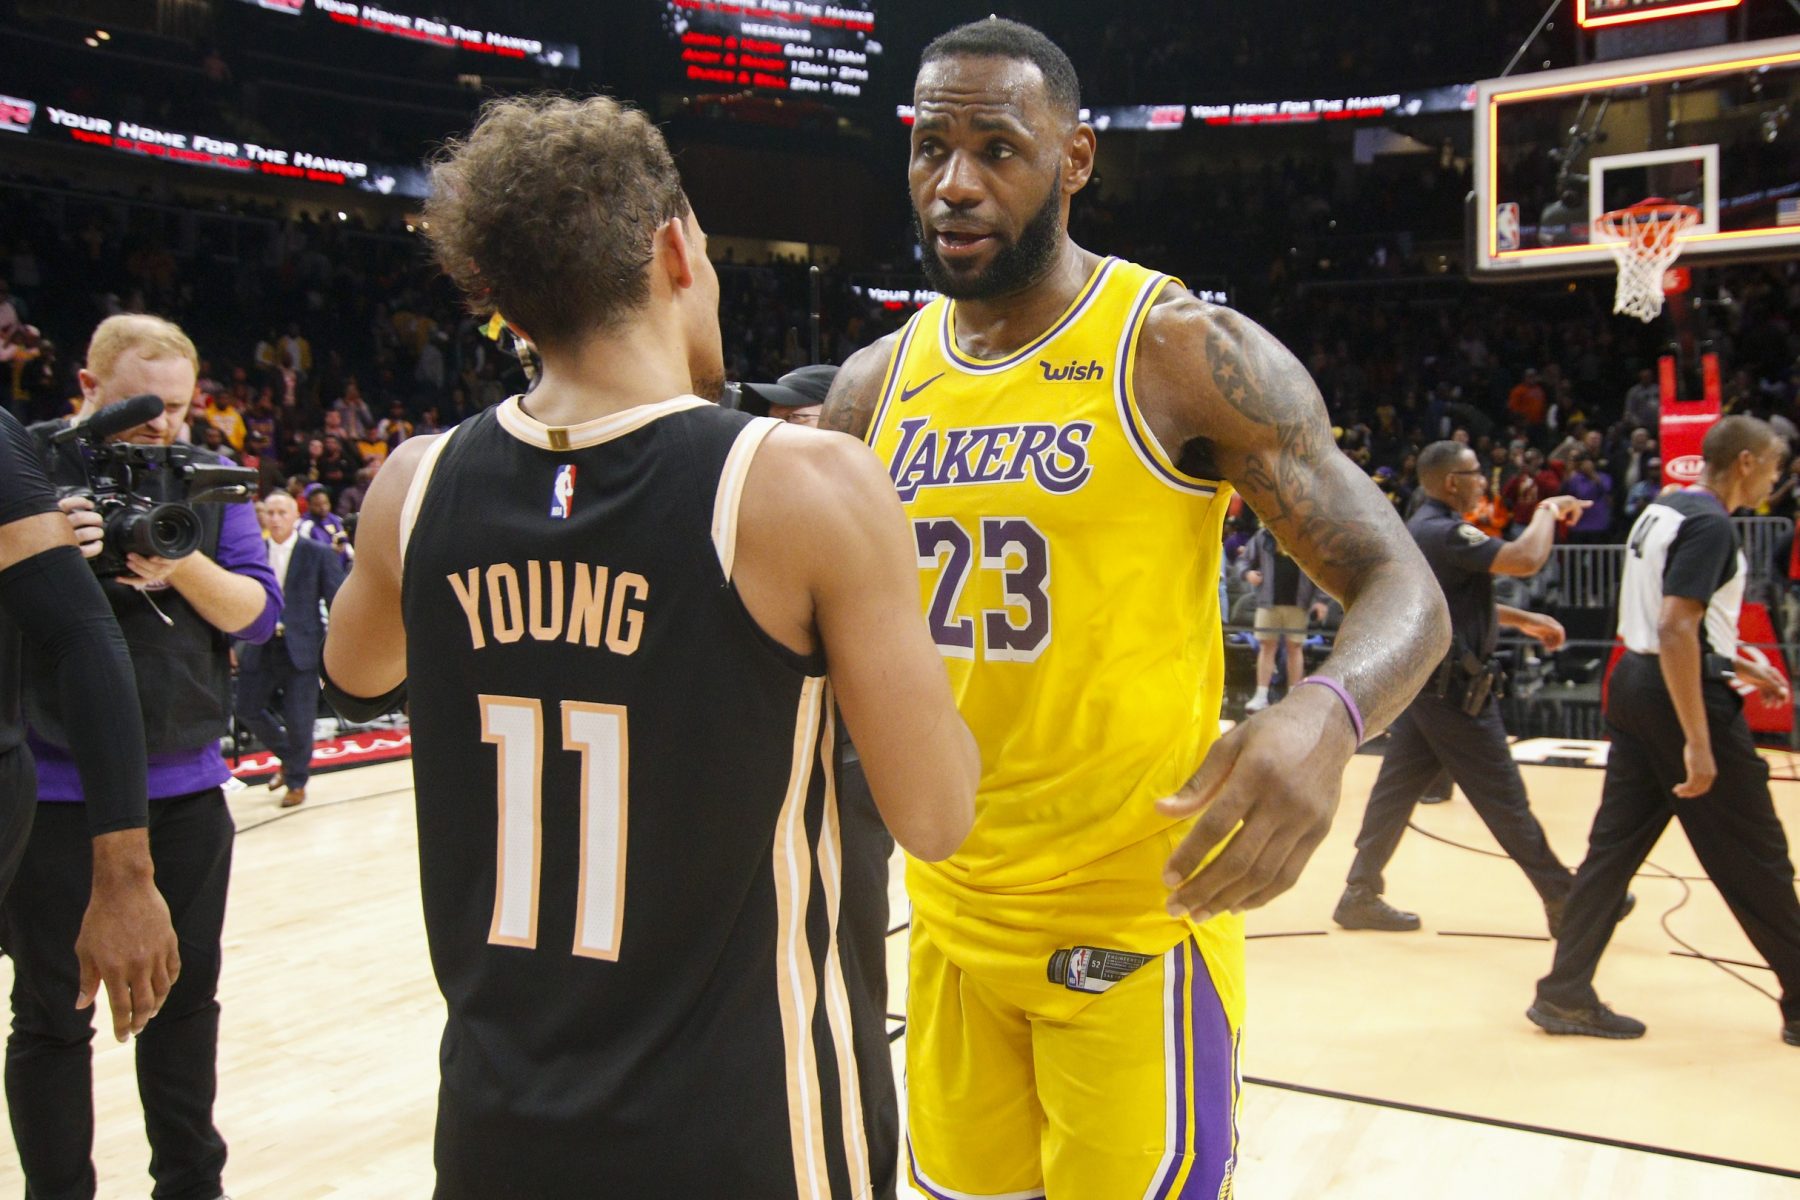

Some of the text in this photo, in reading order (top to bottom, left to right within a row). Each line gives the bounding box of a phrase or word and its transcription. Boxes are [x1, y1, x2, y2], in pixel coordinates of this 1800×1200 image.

[46, 105, 113, 134] YOUR
[118, 121, 187, 149] HOME
[192, 135, 238, 157] FOR
[243, 142, 289, 164] THE
[293, 151, 368, 178] HAWKS
[867, 287, 910, 302] YOUR
[1040, 360, 1104, 381] wish
[889, 415, 1096, 504] LAKERS
[446, 559, 650, 656] YOUNG
[912, 516, 1052, 663] 23
[478, 693, 629, 962] 11
[1091, 960, 1101, 969] 52
